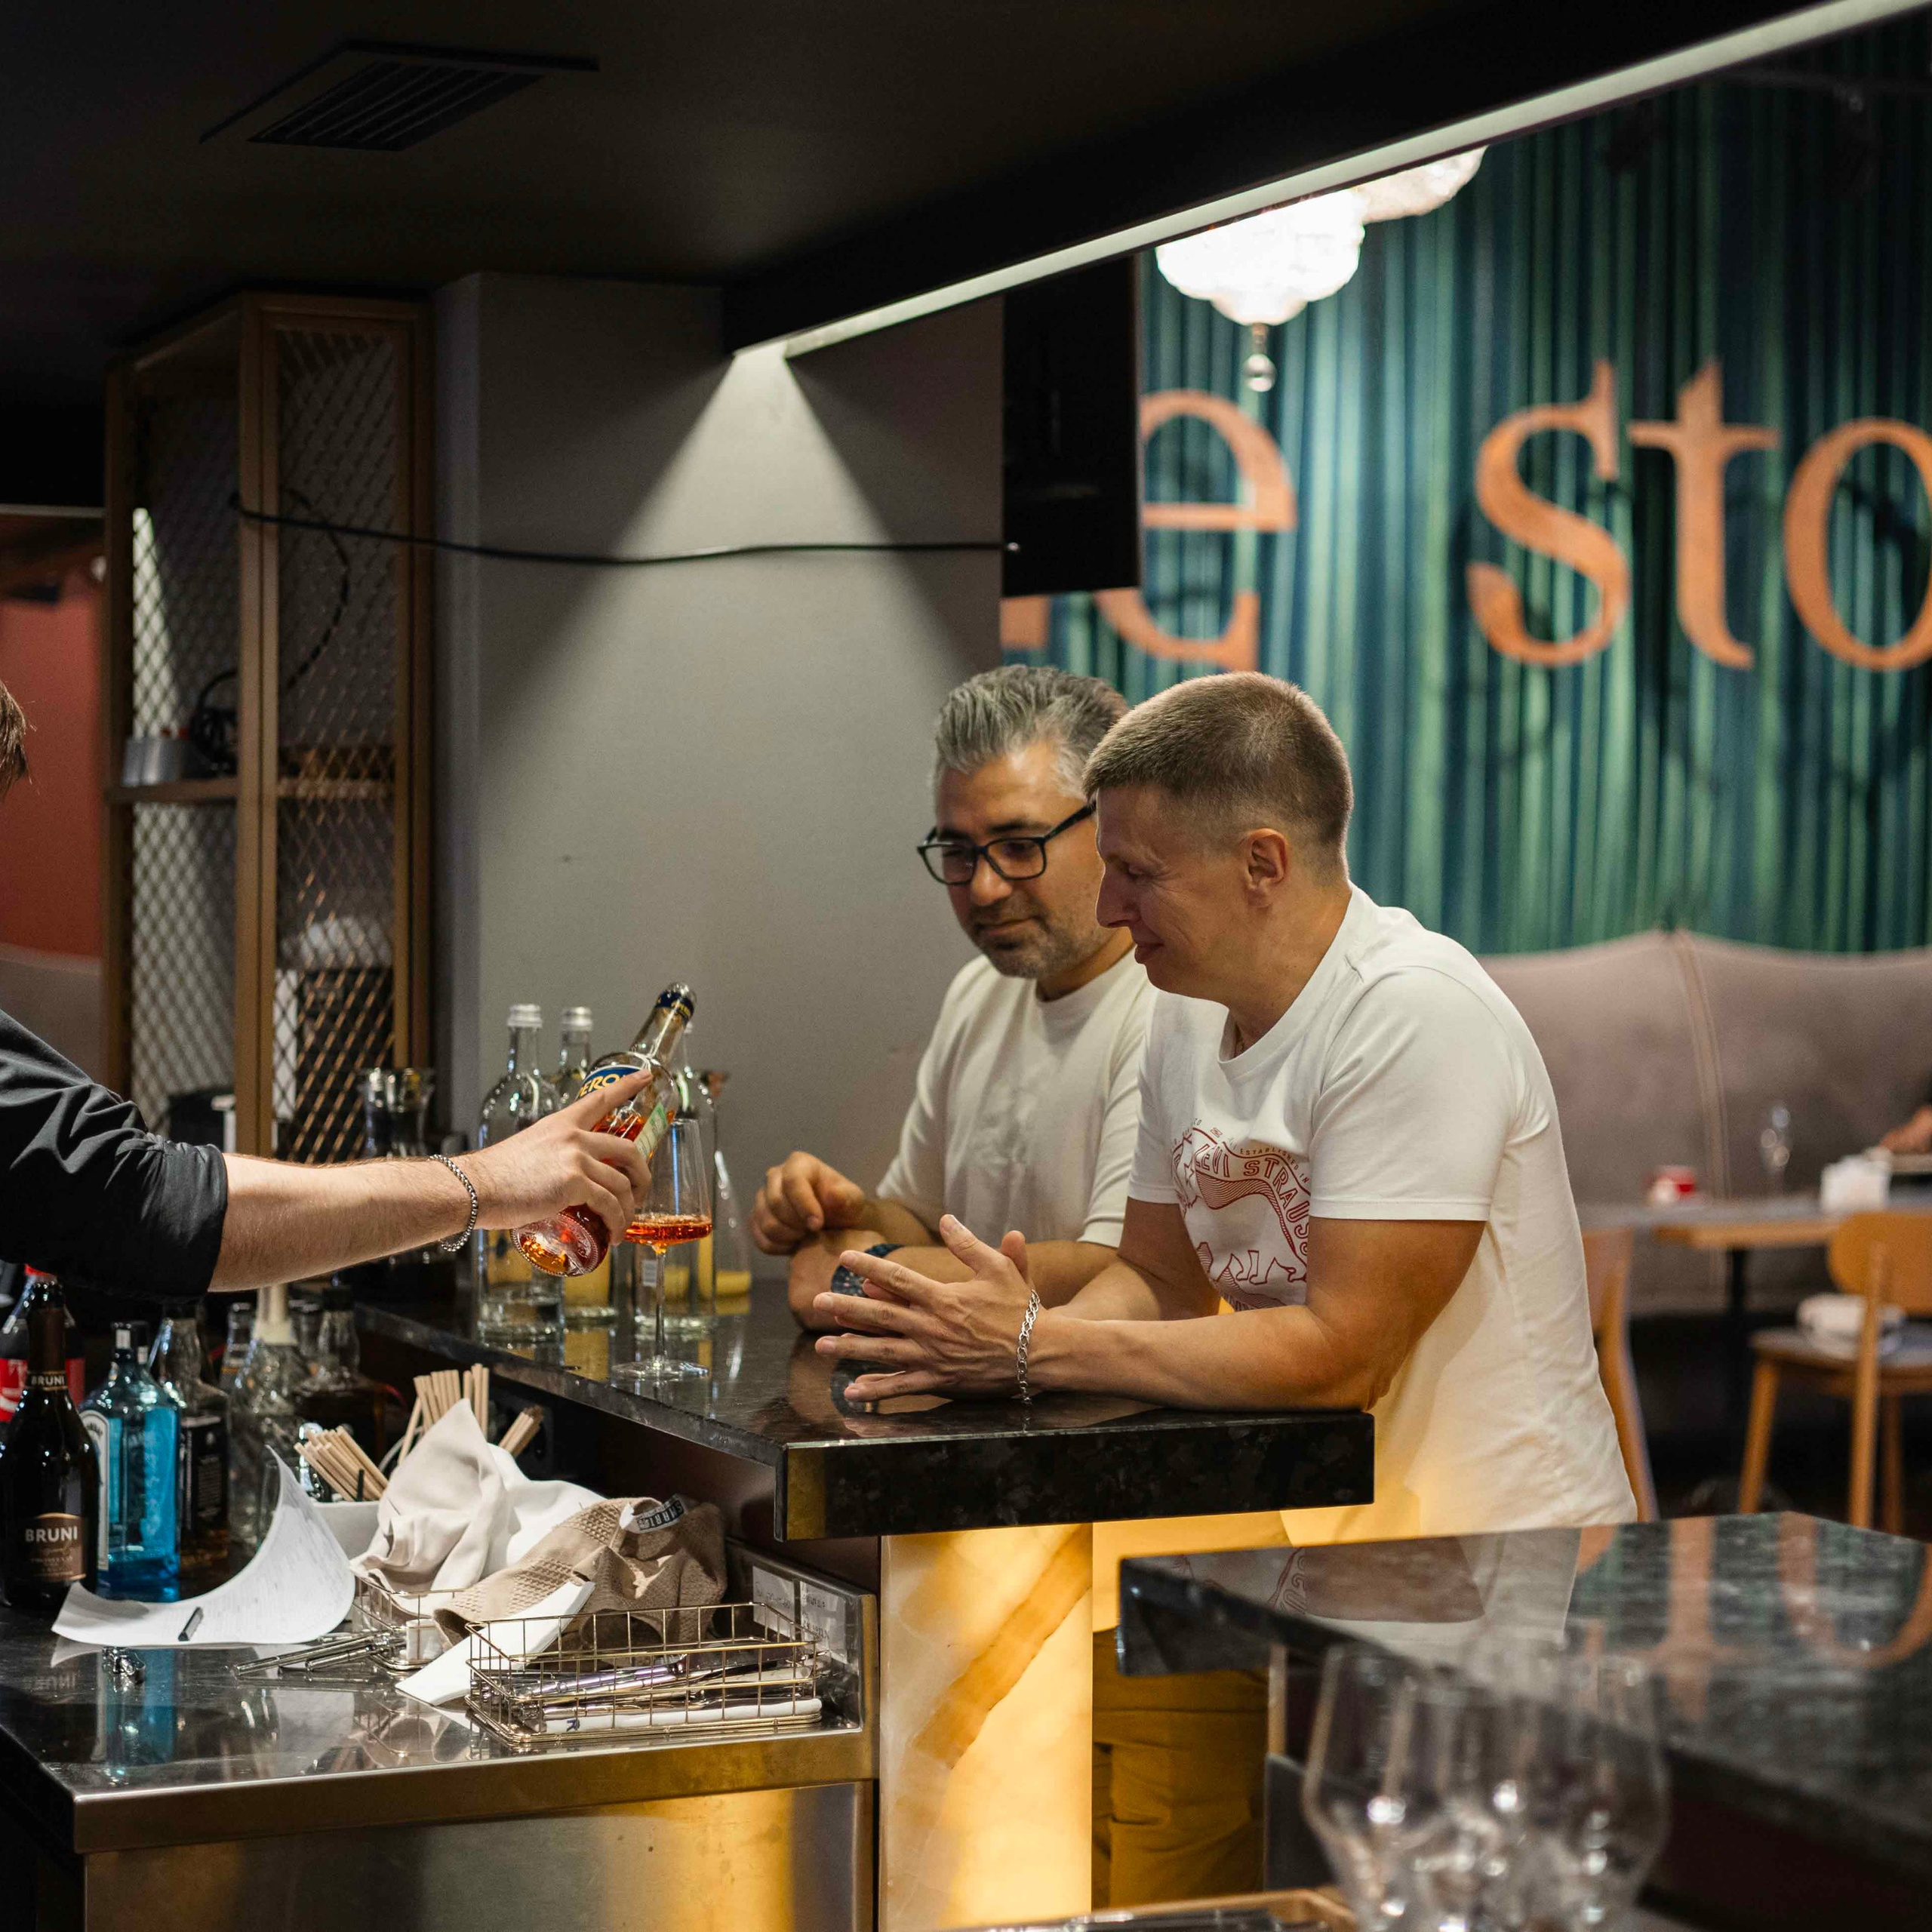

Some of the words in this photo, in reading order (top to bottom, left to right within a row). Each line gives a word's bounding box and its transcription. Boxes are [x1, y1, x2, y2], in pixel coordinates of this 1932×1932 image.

[1194, 1143, 1230, 1178] LEVI
[31, 1375, 66, 1386] BRUNI
[25, 1524, 78, 1543] BRUNI
